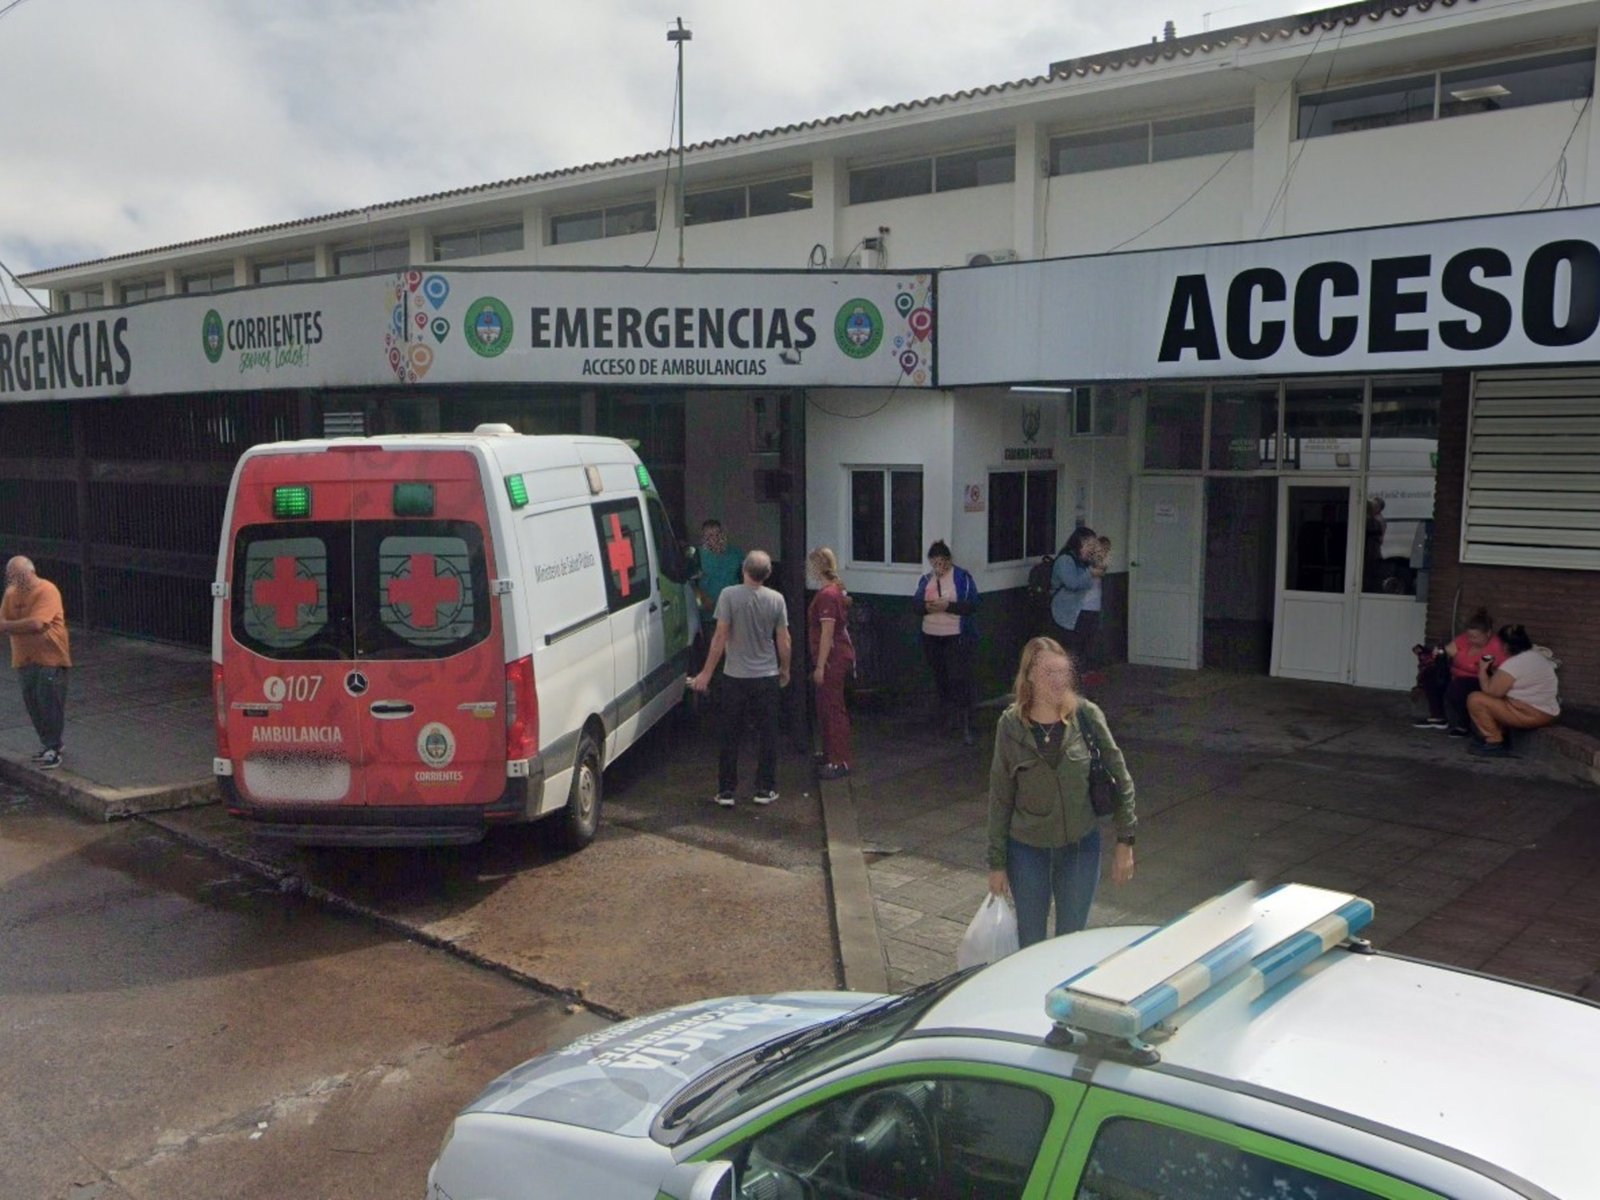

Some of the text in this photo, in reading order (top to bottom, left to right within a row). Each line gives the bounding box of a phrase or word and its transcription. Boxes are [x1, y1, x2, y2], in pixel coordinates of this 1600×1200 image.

[1158, 239, 1600, 362] ACCESO
[227, 310, 323, 351] CORRIENTES
[531, 306, 816, 349] EMERGENCIAS
[0, 317, 131, 392] RGENCIAS
[583, 358, 767, 376] ACCESO DE AMBULANCIAS
[285, 675, 322, 701] 107
[252, 726, 342, 743] AMBULANCIA
[415, 771, 463, 781] CORRIENTES
